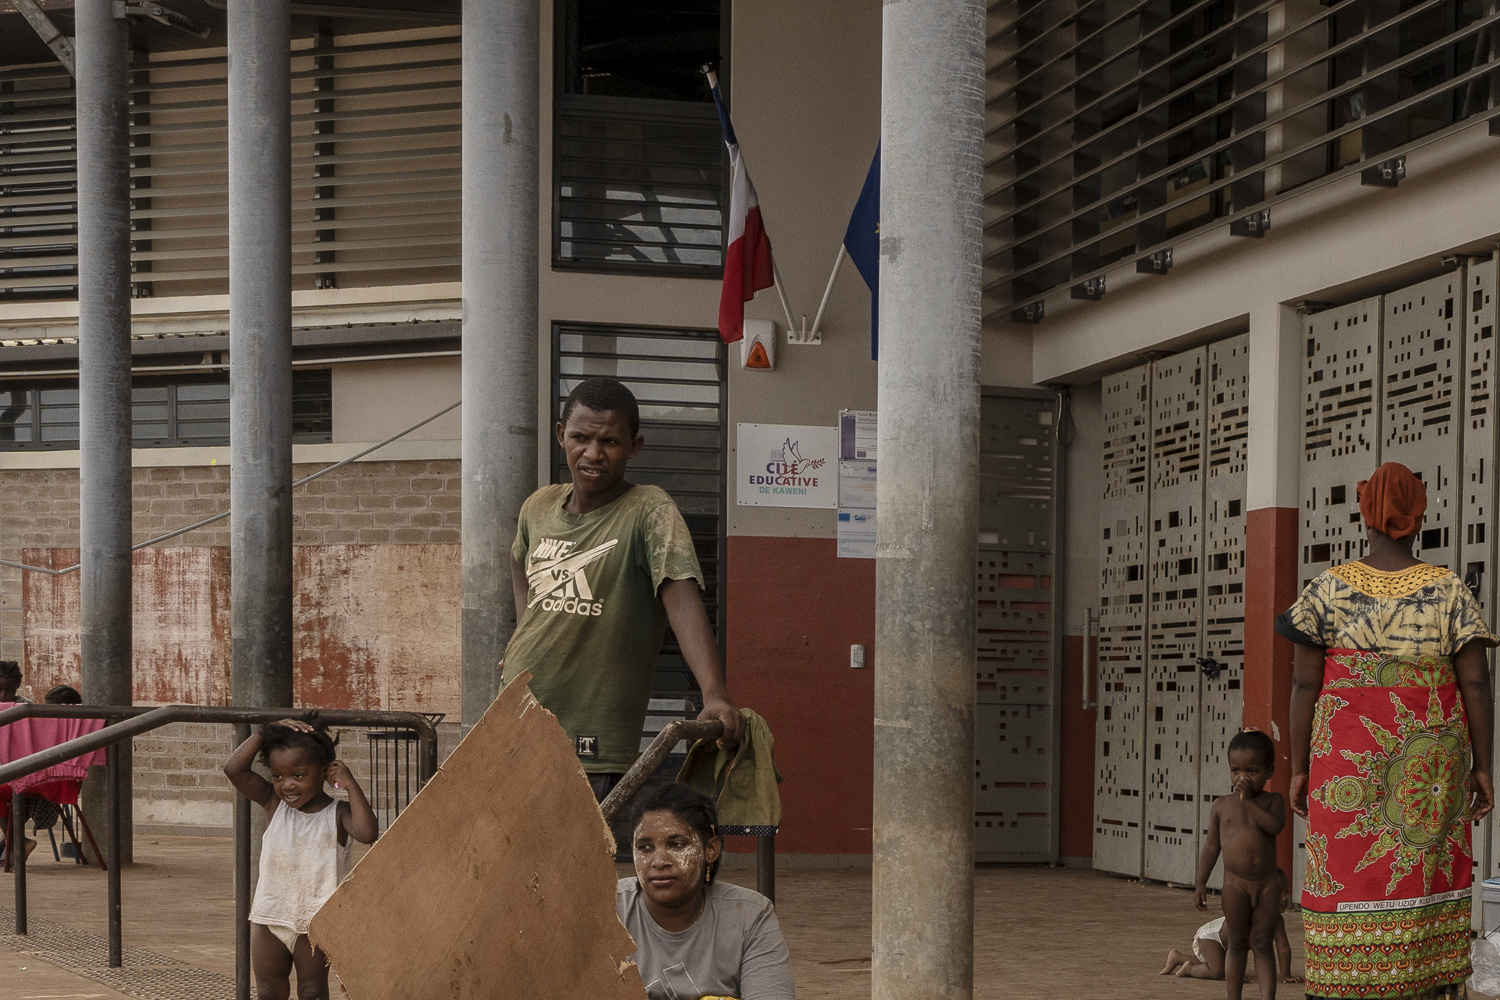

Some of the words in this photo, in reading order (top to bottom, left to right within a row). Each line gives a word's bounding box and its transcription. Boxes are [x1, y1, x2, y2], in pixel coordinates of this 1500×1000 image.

[766, 460, 798, 474] CITÉ
[749, 475, 819, 487] EDUCATIVE
[759, 486, 770, 494] DE
[773, 486, 807, 496] KAWENI
[532, 538, 573, 559] NIKE
[541, 598, 603, 617] adidas
[1339, 902, 1369, 911] UPENDO
[1373, 901, 1395, 909] WETU
[1398, 899, 1417, 908] UZIDI
